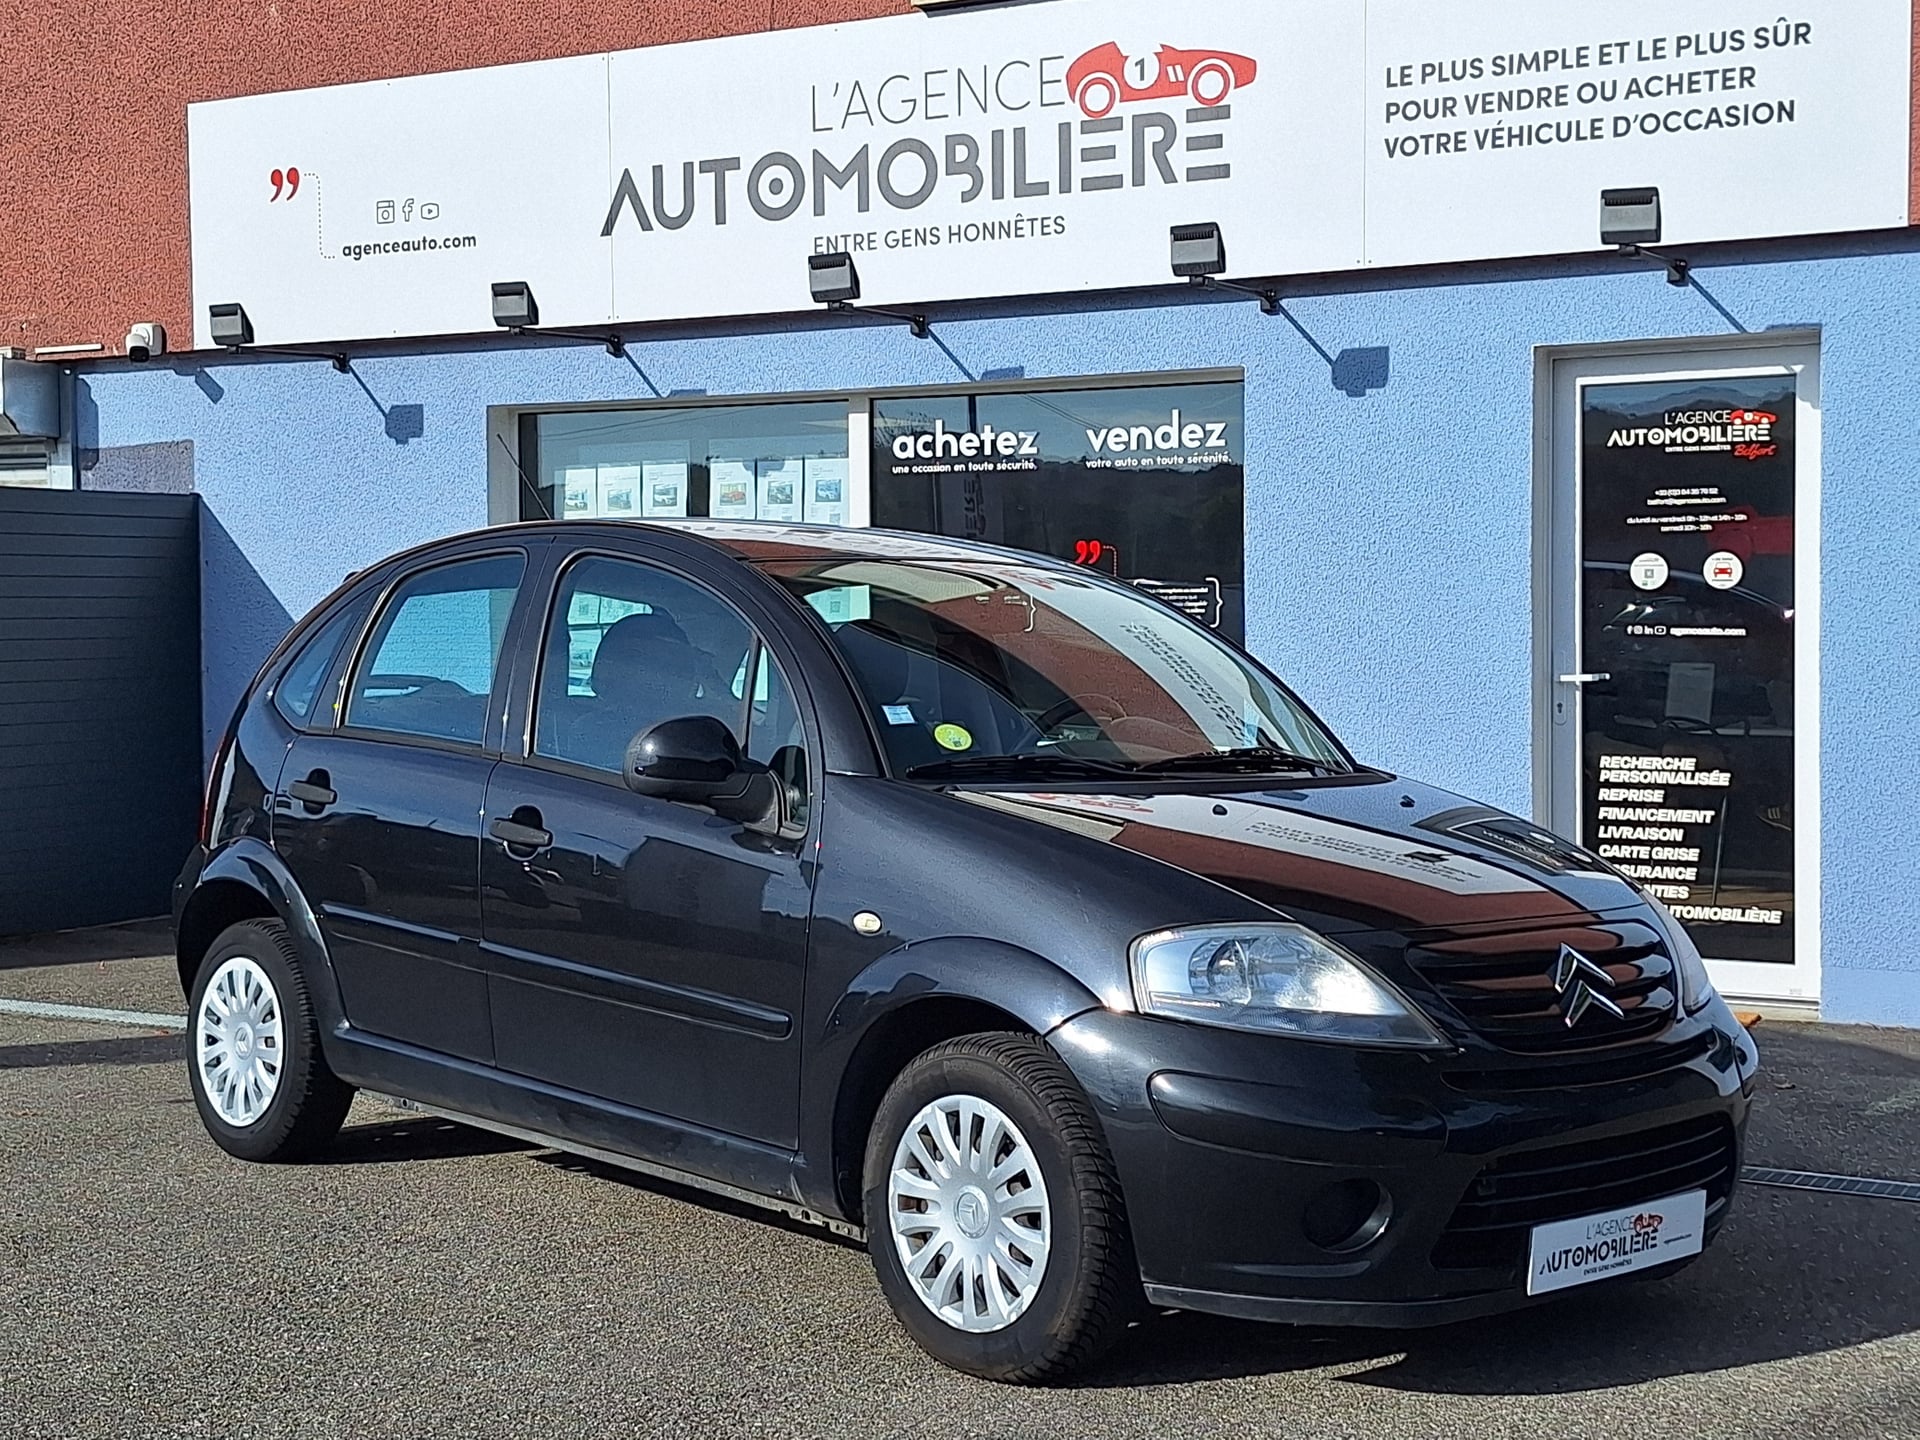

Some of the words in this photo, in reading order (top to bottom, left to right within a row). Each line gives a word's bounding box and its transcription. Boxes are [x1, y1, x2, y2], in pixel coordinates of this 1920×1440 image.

[1386, 66, 1413, 88] LE
[1421, 58, 1484, 84] PLUS
[1492, 46, 1589, 76] SIMPLE
[1599, 41, 1629, 65] ET
[1638, 37, 1667, 61] LE
[1676, 29, 1745, 58] PLUS
[1754, 17, 1812, 49] SÛR
[811, 55, 1065, 132] L'AGENCE
[1386, 97, 1457, 123] POUR
[1464, 85, 1568, 116] VENDRE
[1577, 80, 1618, 103] OU
[1624, 66, 1756, 100] ACHETER
[1384, 132, 1467, 158] VOTRE
[1474, 118, 1603, 150] VÉHICULE
[814, 231, 877, 256] ENTRE
[884, 225, 941, 250] GENS
[948, 212, 1065, 244] HONNÊTES
[342, 233, 477, 261] agenceauto.com
[1086, 409, 1226, 452] vendez
[893, 419, 1038, 460] achetez
[892, 466, 909, 474] une
[912, 462, 951, 473] occasion
[954, 464, 966, 472] en
[969, 462, 994, 472] toute
[1086, 459, 1111, 468] votre
[1114, 457, 1138, 467] auto
[1141, 457, 1154, 466] en
[1157, 455, 1184, 465] toute
[1599, 755, 1696, 771] RECHERCHE
[1599, 770, 1731, 787] PERSONNALISÉE
[1598, 788, 1665, 803] REPRISE
[1598, 807, 1715, 823] FINANCEMENT
[1598, 826, 1684, 842] LIVRAISON
[1598, 845, 1651, 859] CARTE
[1652, 847, 1700, 862] GRISE
[1613, 864, 1698, 881] SURANCE
